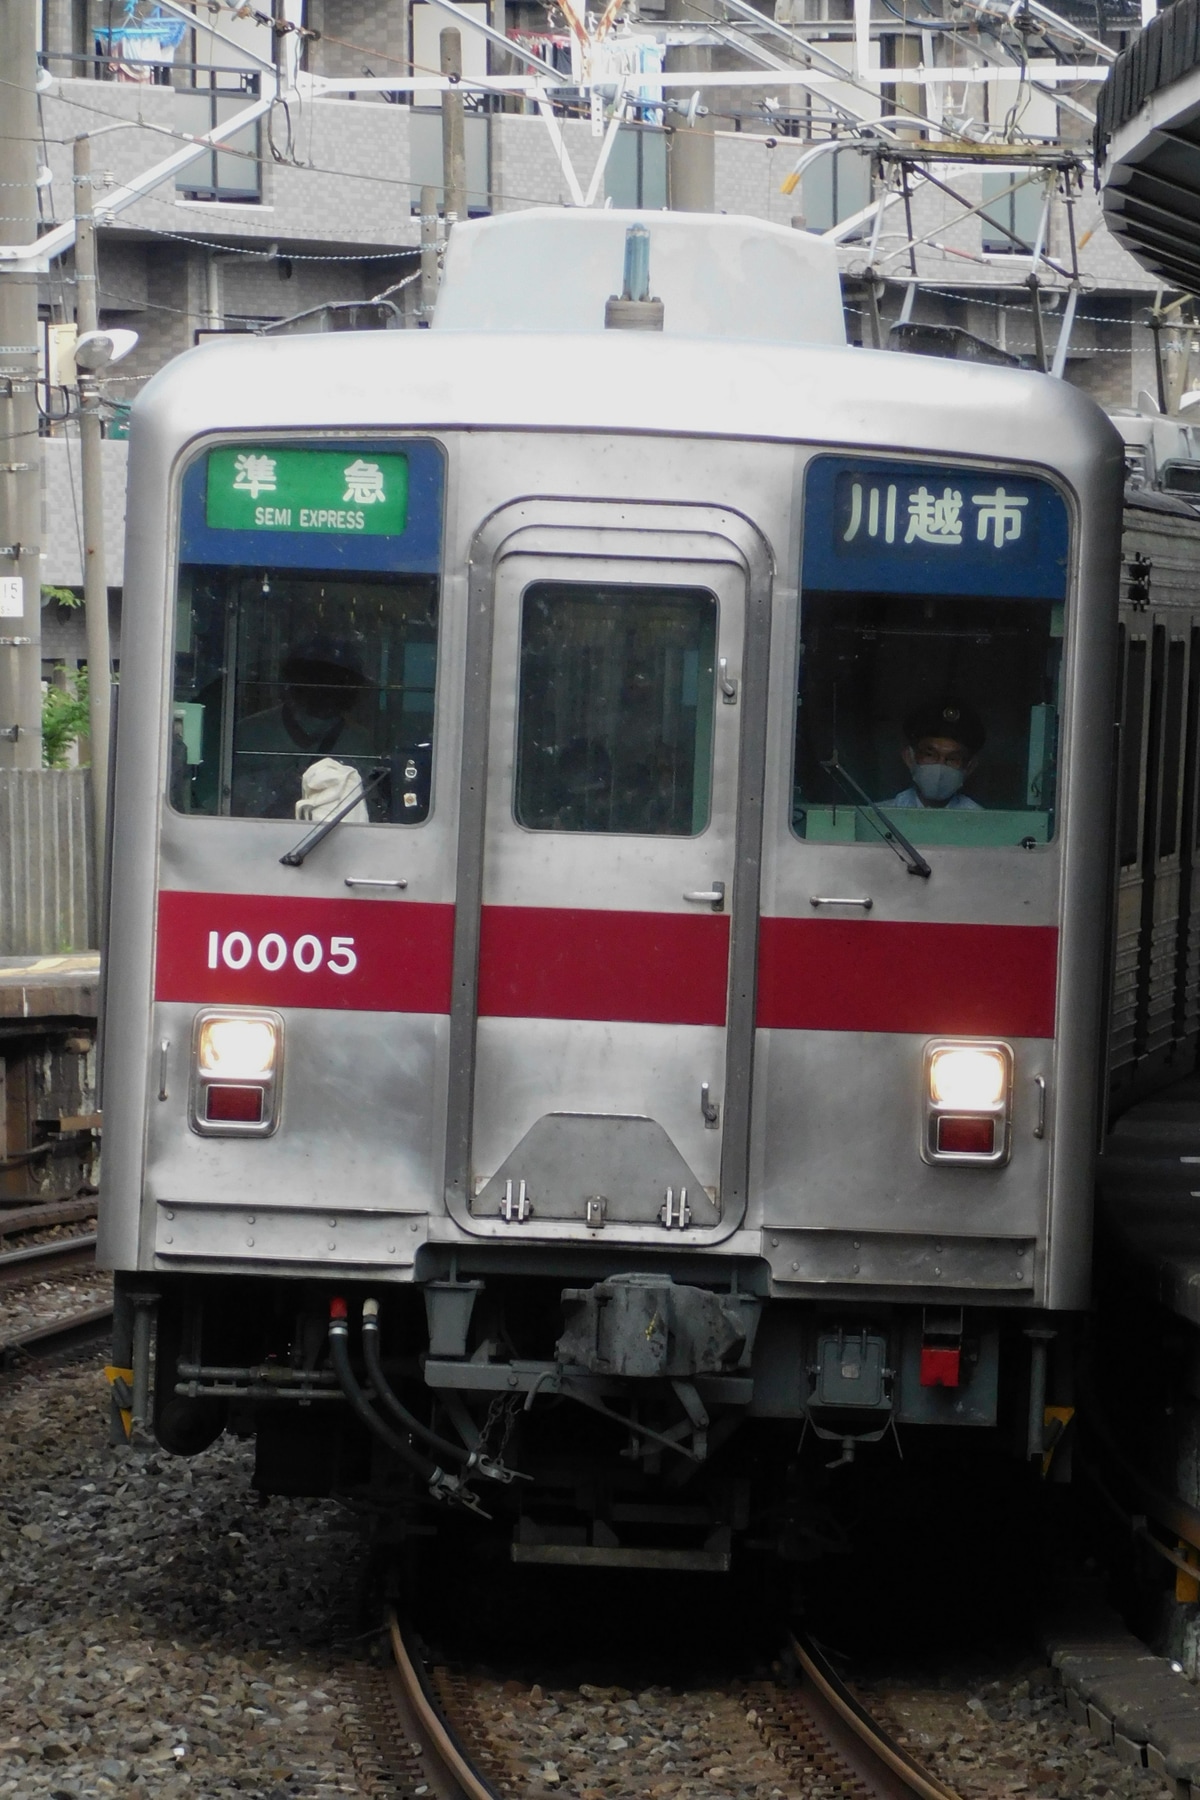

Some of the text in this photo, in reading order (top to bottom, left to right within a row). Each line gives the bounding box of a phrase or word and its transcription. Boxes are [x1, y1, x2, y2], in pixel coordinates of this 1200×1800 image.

[254, 507, 365, 529] SEMI EXPRESS
[843, 484, 1029, 548] 川越市
[208, 931, 357, 975] 10005
